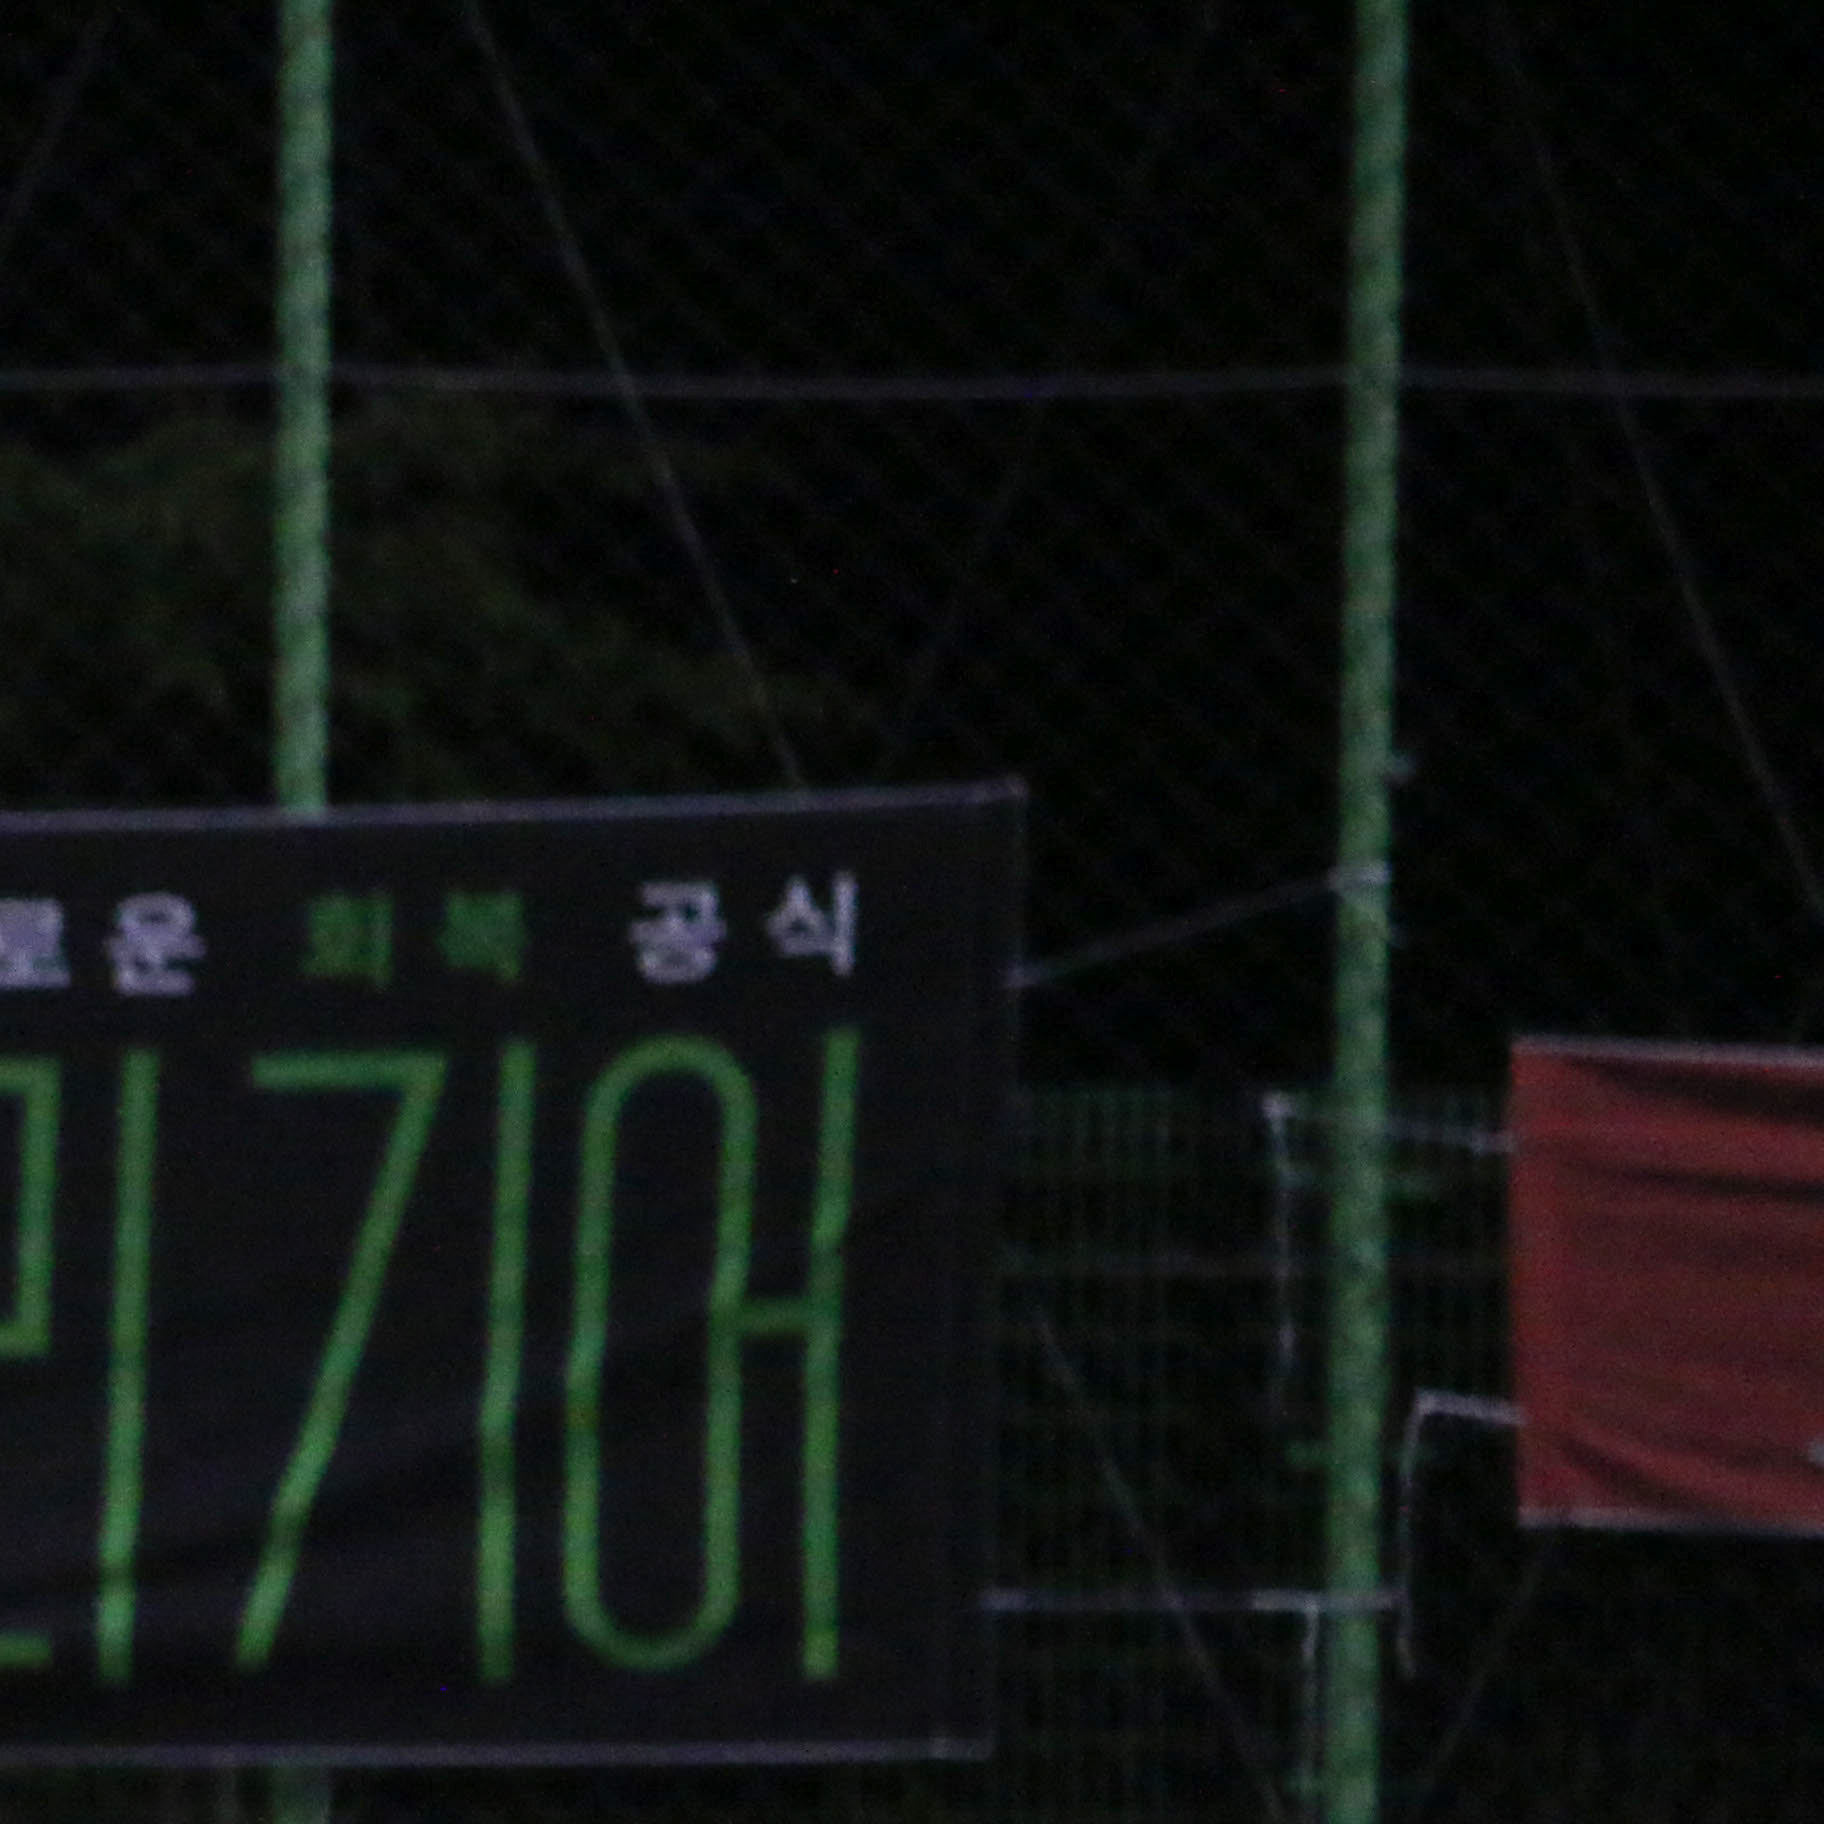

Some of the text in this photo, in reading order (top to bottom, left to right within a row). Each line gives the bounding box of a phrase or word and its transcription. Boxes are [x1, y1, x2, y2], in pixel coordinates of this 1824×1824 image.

[300, 888, 530, 986] 회복
[628, 870, 860, 985] 공식
[233, 1023, 863, 1685] 기어
